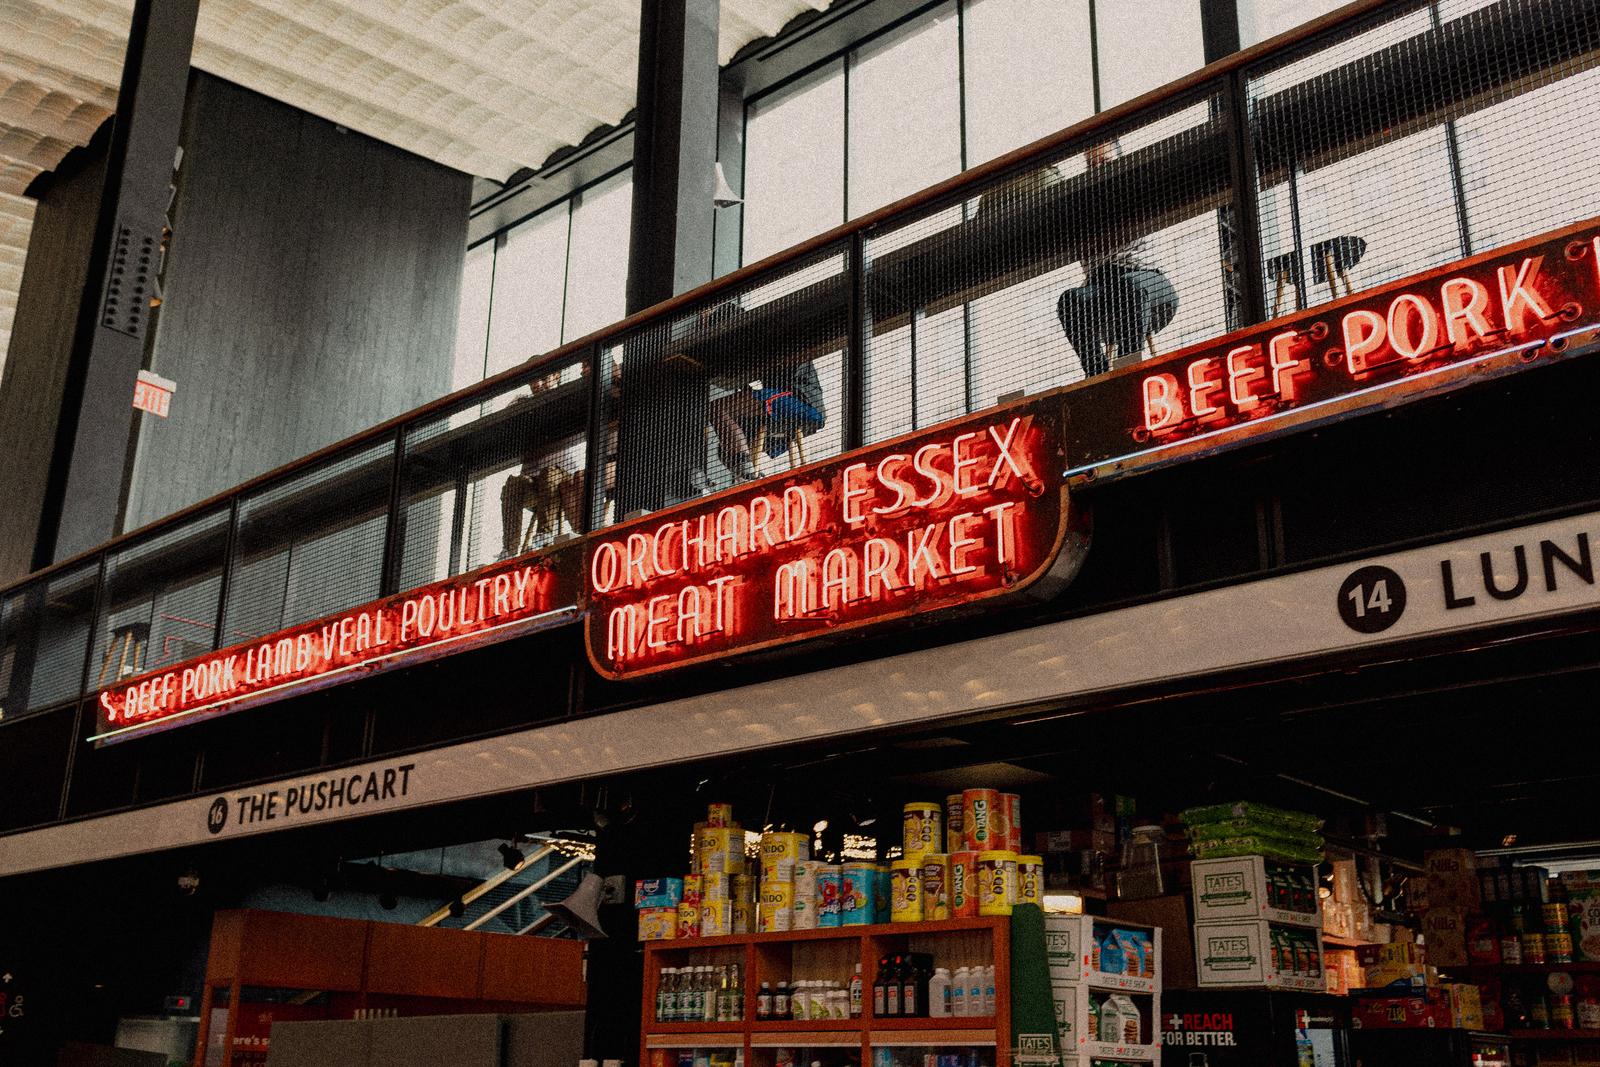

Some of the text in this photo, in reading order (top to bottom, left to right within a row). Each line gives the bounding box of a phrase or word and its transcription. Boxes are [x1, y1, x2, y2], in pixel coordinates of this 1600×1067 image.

[1142, 330, 1300, 432] BEEF
[1342, 257, 1547, 376] PORK
[590, 417, 1024, 595] ORCHARD ESSEX
[607, 501, 1016, 662] MEAT MARKET
[1348, 532, 1595, 618] 14 LUN
[123, 673, 175, 718] BEEF
[181, 655, 237, 702] PORK
[245, 634, 309, 682] LAMB
[321, 607, 389, 660] VEAL
[401, 565, 533, 642] POULTRY
[237, 790, 279, 825] THE
[284, 763, 415, 817] PUSHCART
[974, 799, 987, 829] TANG
[954, 864, 963, 895] TANG
[1162, 1031, 1185, 1046] FOR
[1183, 1012, 1234, 1030] REACH
